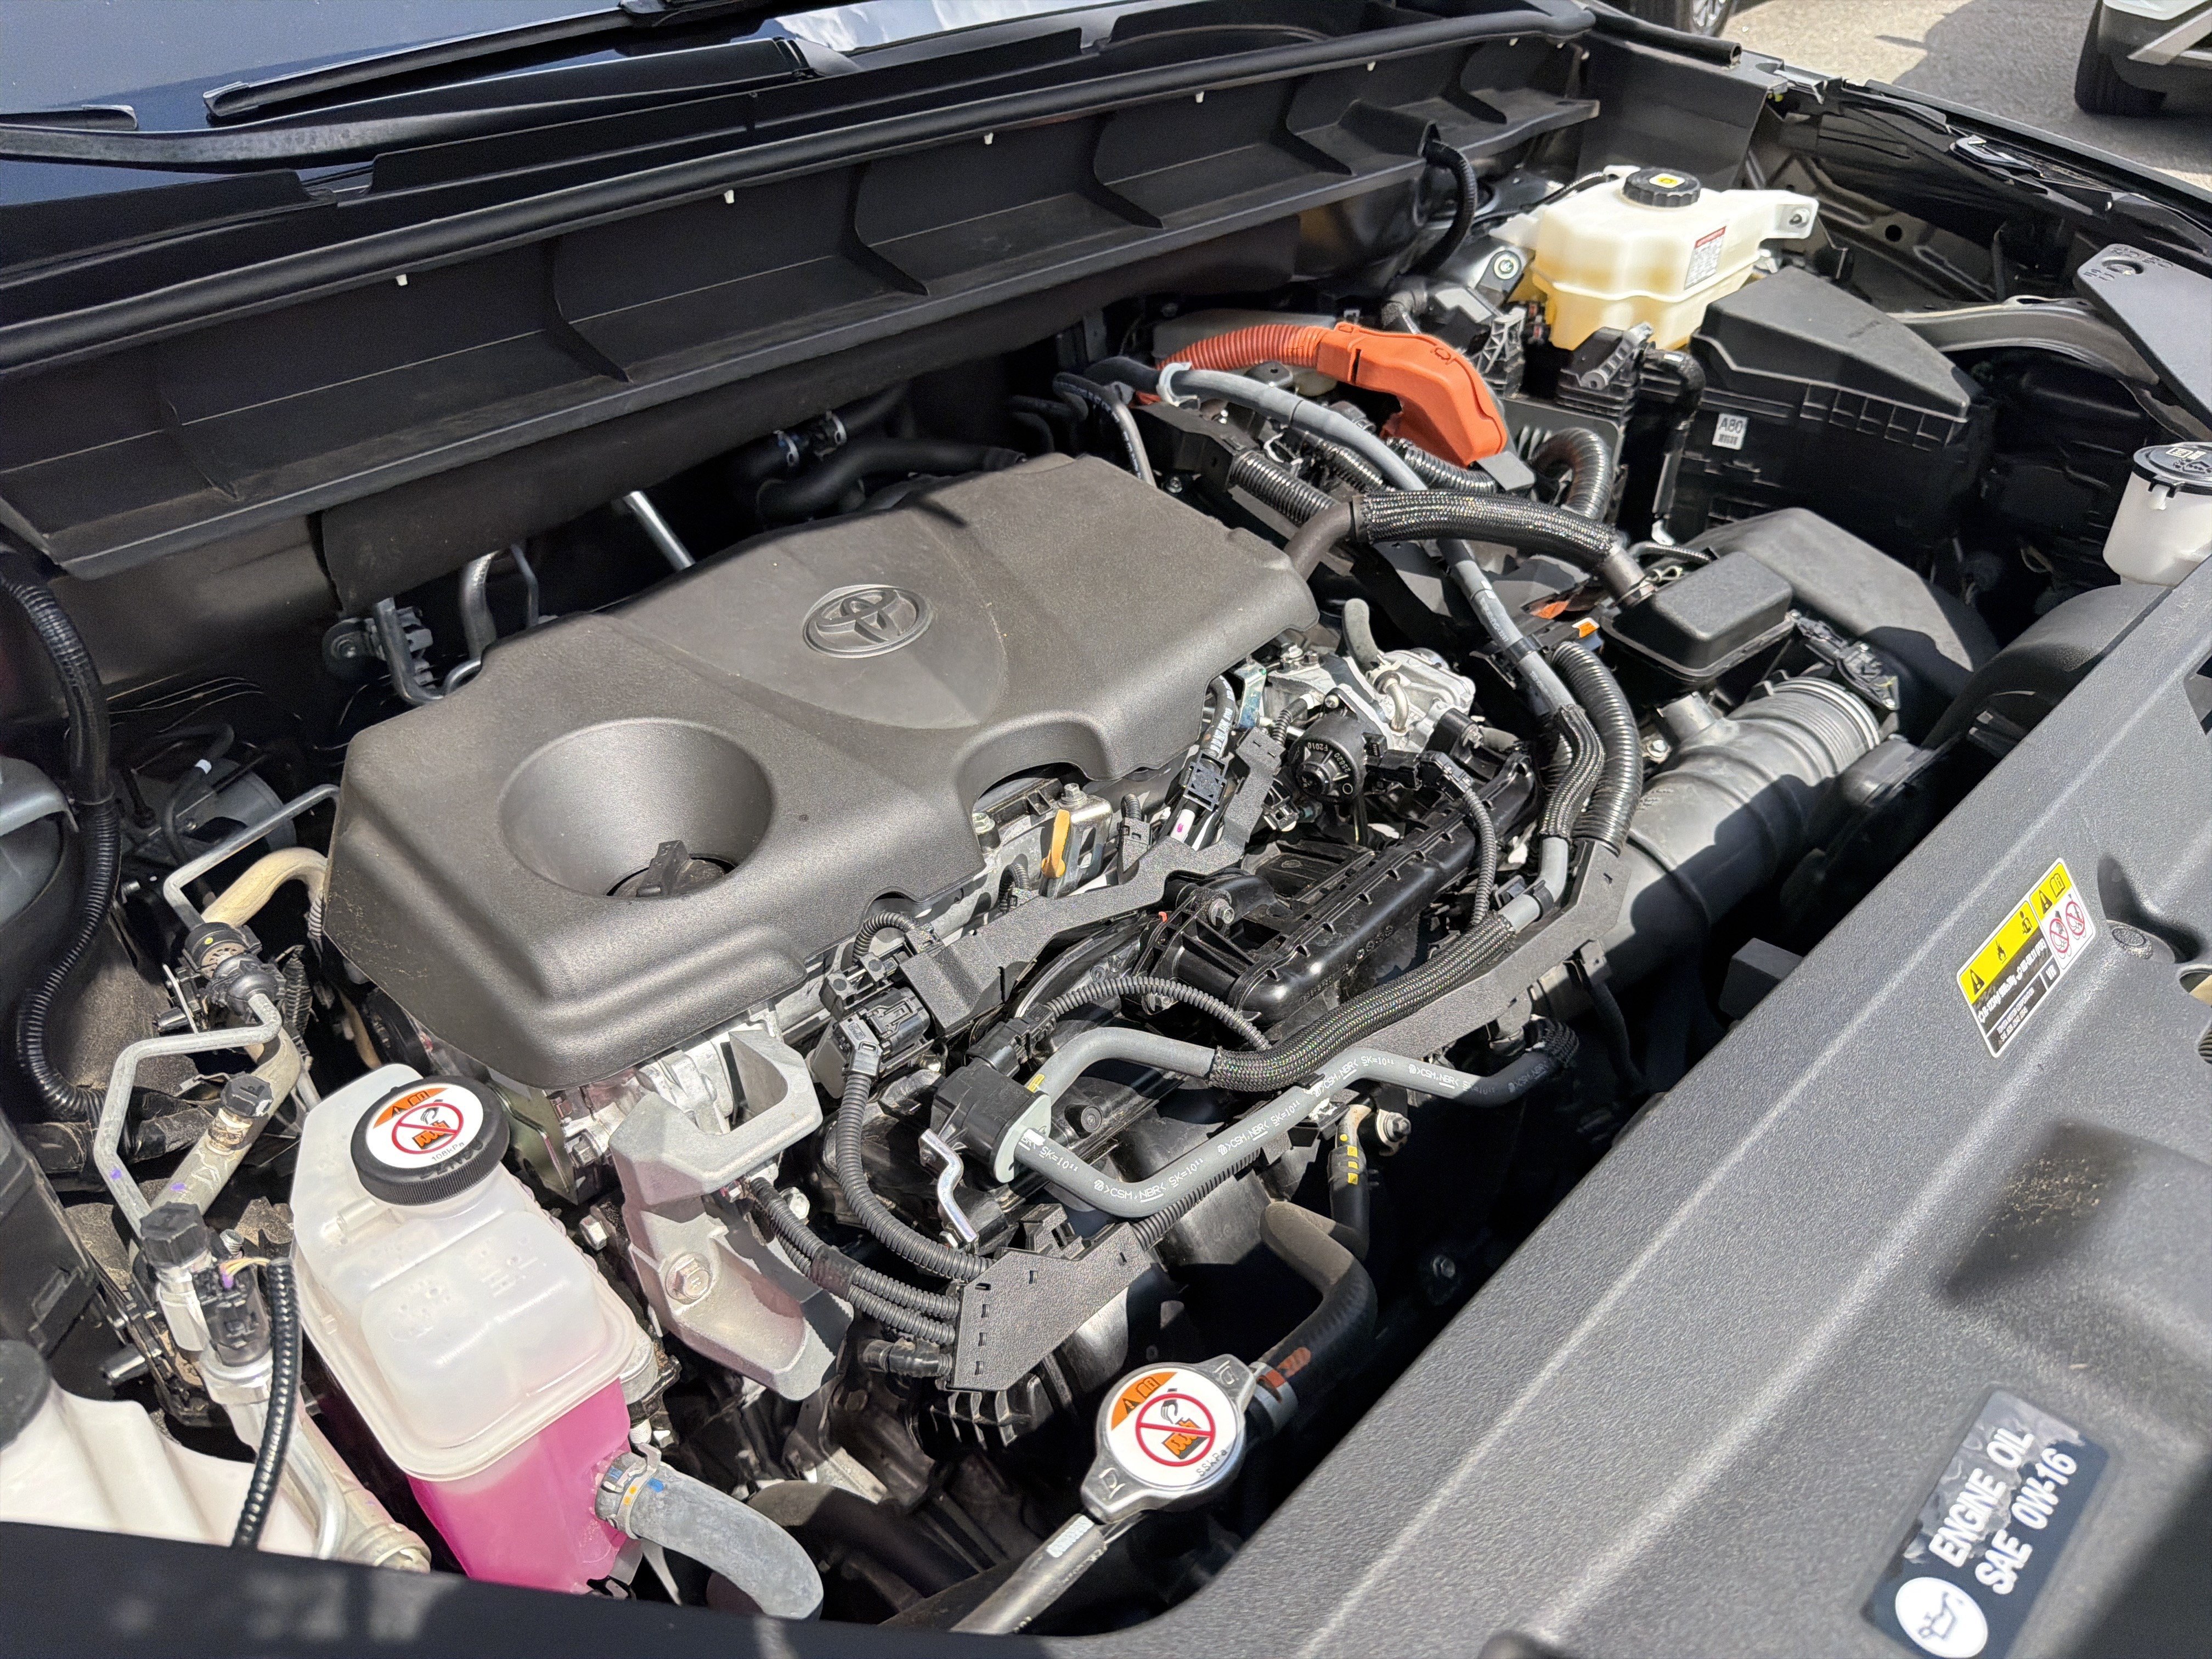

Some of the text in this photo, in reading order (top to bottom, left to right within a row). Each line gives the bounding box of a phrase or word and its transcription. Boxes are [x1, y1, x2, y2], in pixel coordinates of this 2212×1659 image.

[1718, 417, 1743, 434] A80
[1307, 742, 1328, 752] F2010
[431, 1141, 465, 1162] 108kPa
[1928, 1427, 2035, 1567] ENGINE OIL
[1974, 1448, 2077, 1595] SAE 0W-16
